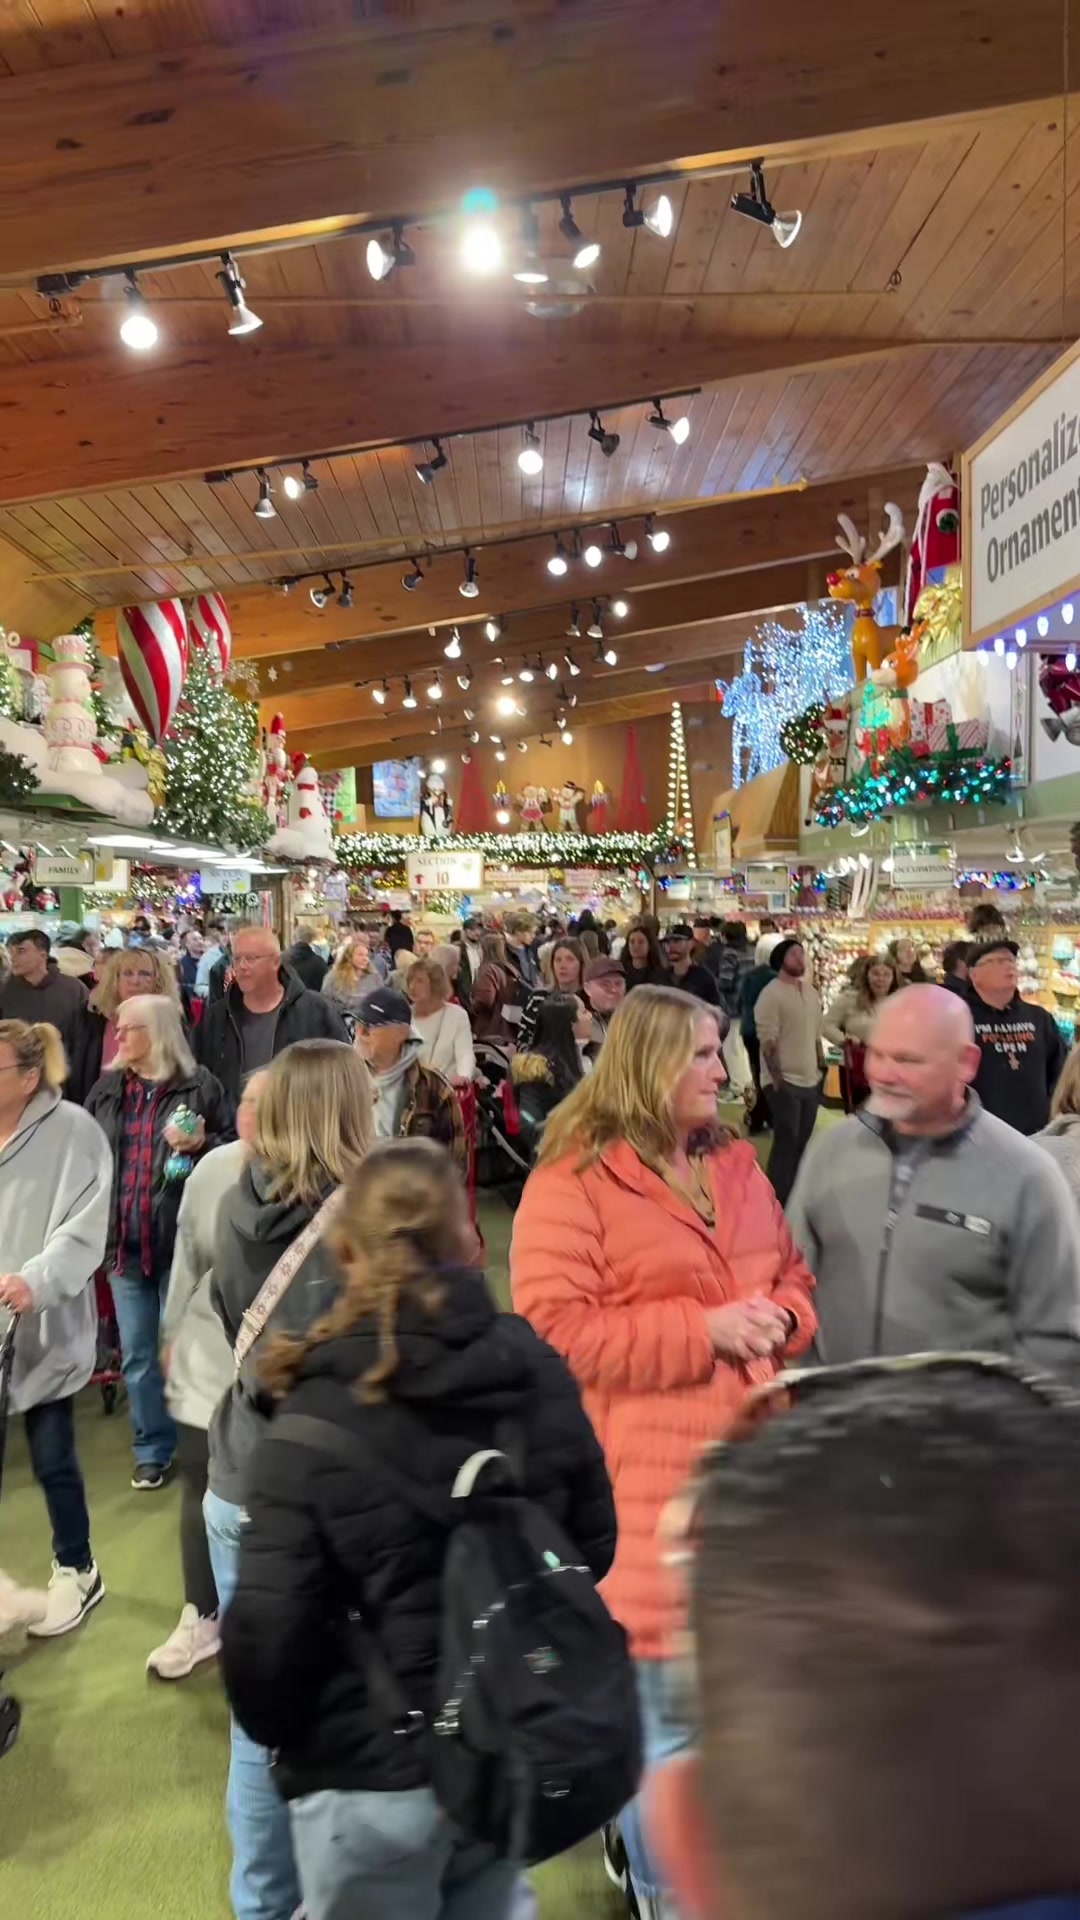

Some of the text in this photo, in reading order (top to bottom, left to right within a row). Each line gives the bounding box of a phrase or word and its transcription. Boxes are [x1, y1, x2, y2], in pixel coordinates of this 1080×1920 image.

[980, 411, 1080, 529] Personaliz
[418, 857, 457, 867] SECTION
[48, 866, 79, 874] FAMILY
[436, 871, 450, 885] 10
[994, 1042, 1027, 1053] OPEN
